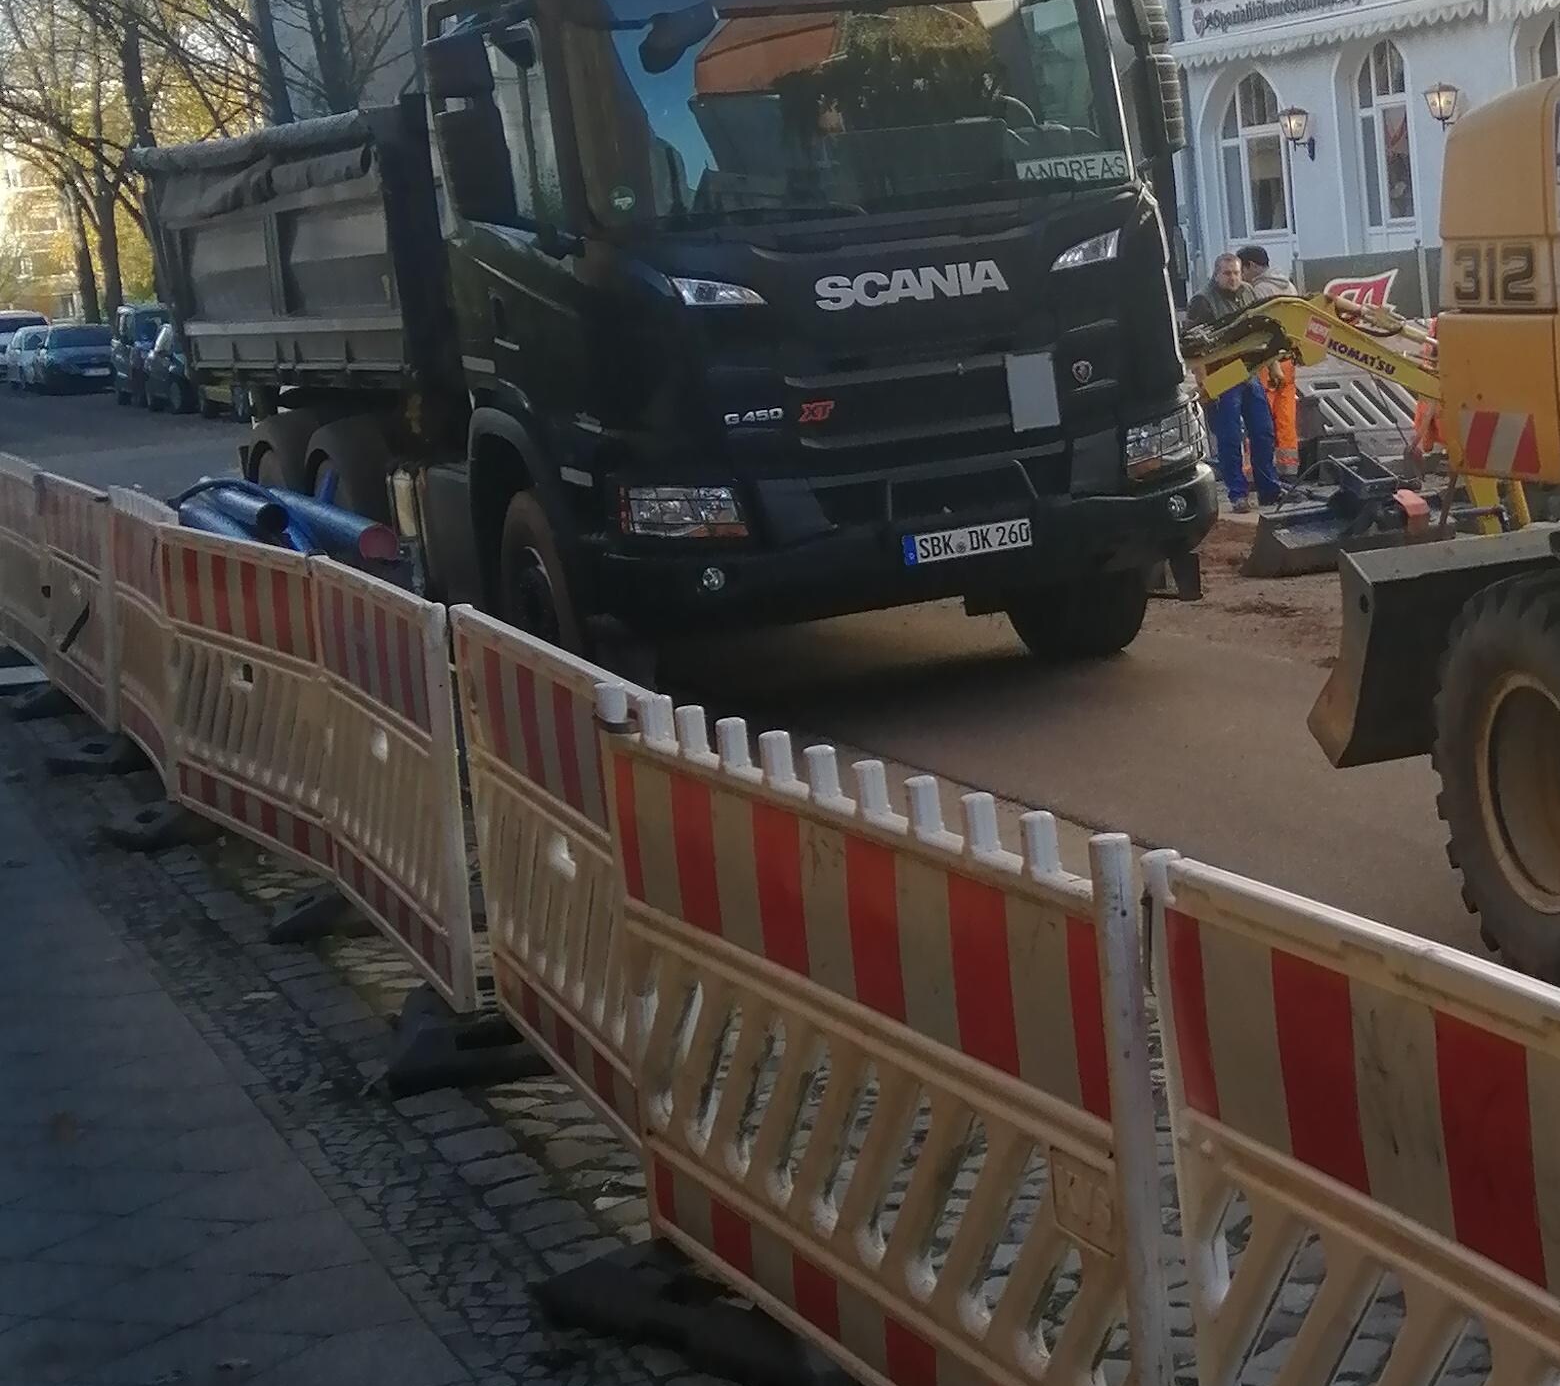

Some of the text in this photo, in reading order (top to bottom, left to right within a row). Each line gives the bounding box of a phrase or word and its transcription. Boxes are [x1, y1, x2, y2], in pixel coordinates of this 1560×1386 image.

[1025, 155, 1126, 180] ANDREAS
[814, 260, 1010, 311] SCANIA
[1454, 243, 1537, 303] 312
[1327, 338, 1397, 375] KOMATSU
[742, 408, 783, 423] 450
[798, 400, 835, 422] XT
[919, 522, 1031, 559] SBK DK 260
